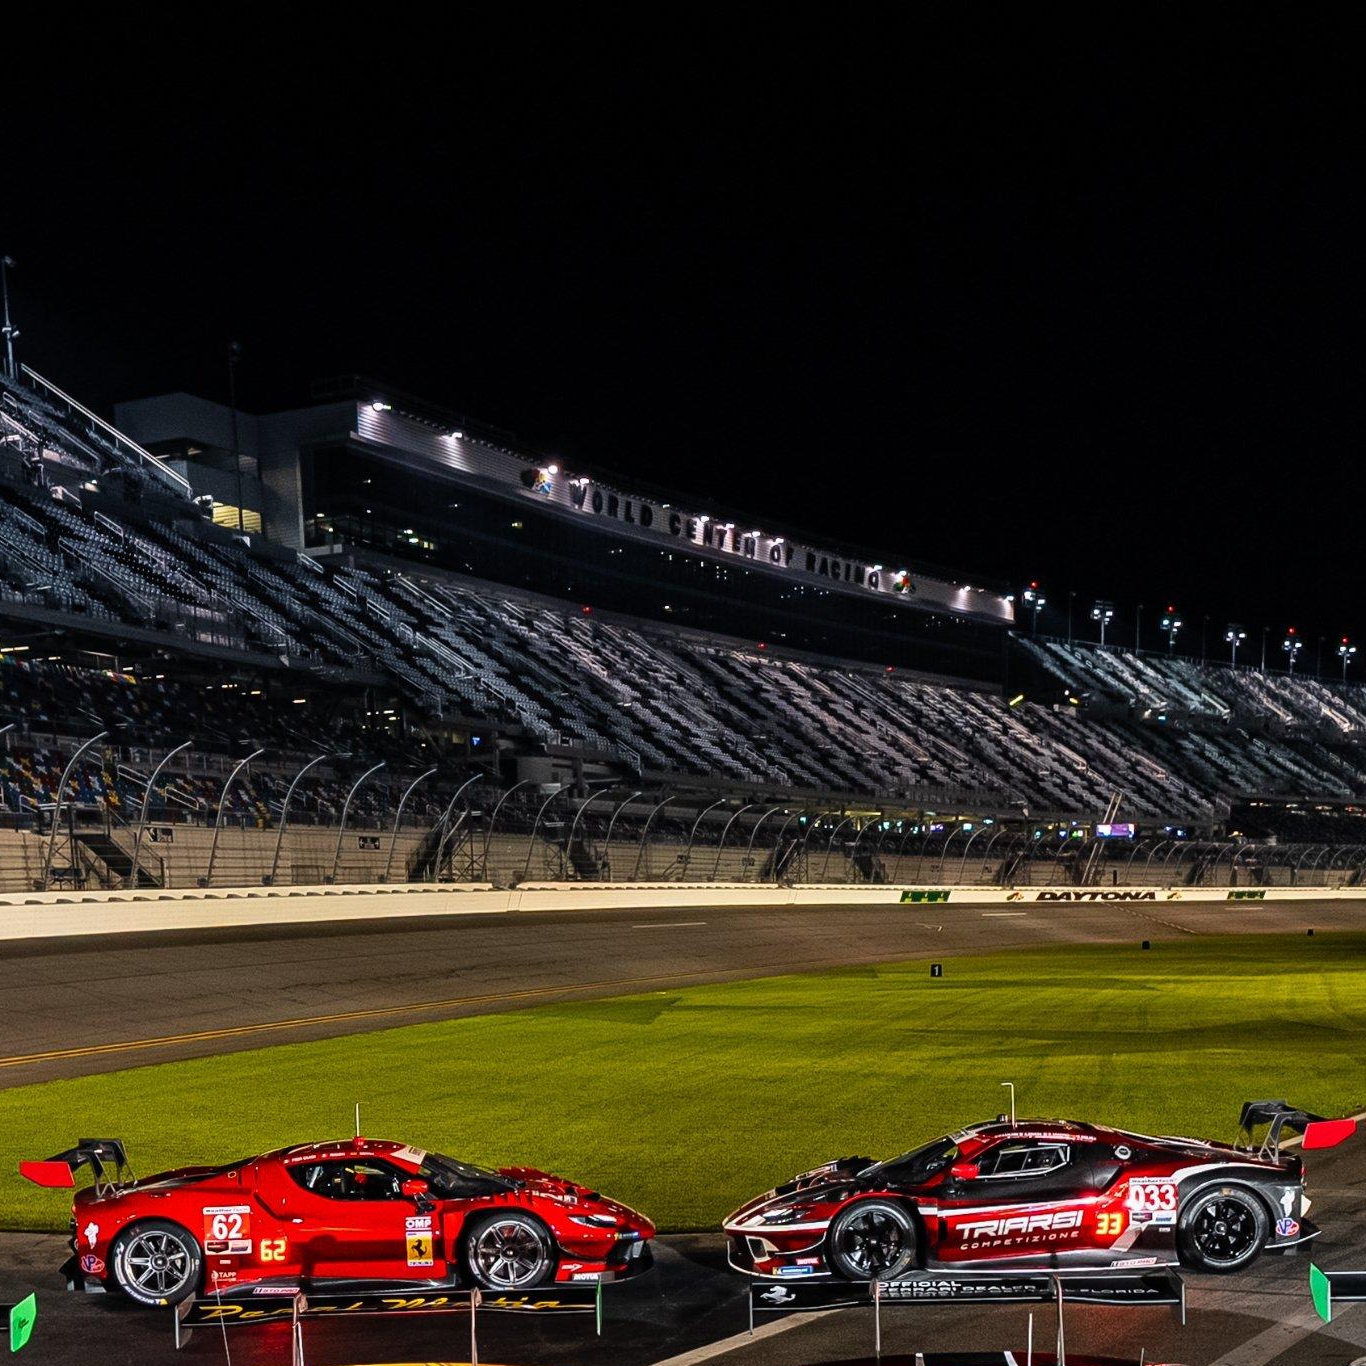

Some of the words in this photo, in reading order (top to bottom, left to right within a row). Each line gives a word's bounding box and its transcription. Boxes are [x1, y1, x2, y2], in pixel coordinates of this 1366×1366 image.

[569, 482, 653, 527] WORLD
[669, 512, 756, 559] CENTER
[769, 545, 794, 567] OF
[805, 552, 880, 590] RACING
[1035, 891, 1157, 901] DAYTONA
[1129, 1184, 1176, 1211] 033
[212, 1214, 243, 1239] 62
[406, 1219, 432, 1228] OMP
[955, 1210, 1084, 1240] TRIARSI
[1095, 1213, 1123, 1235] 33
[260, 1239, 286, 1261] 62
[960, 1231, 1080, 1251] COMPETIZIONE
